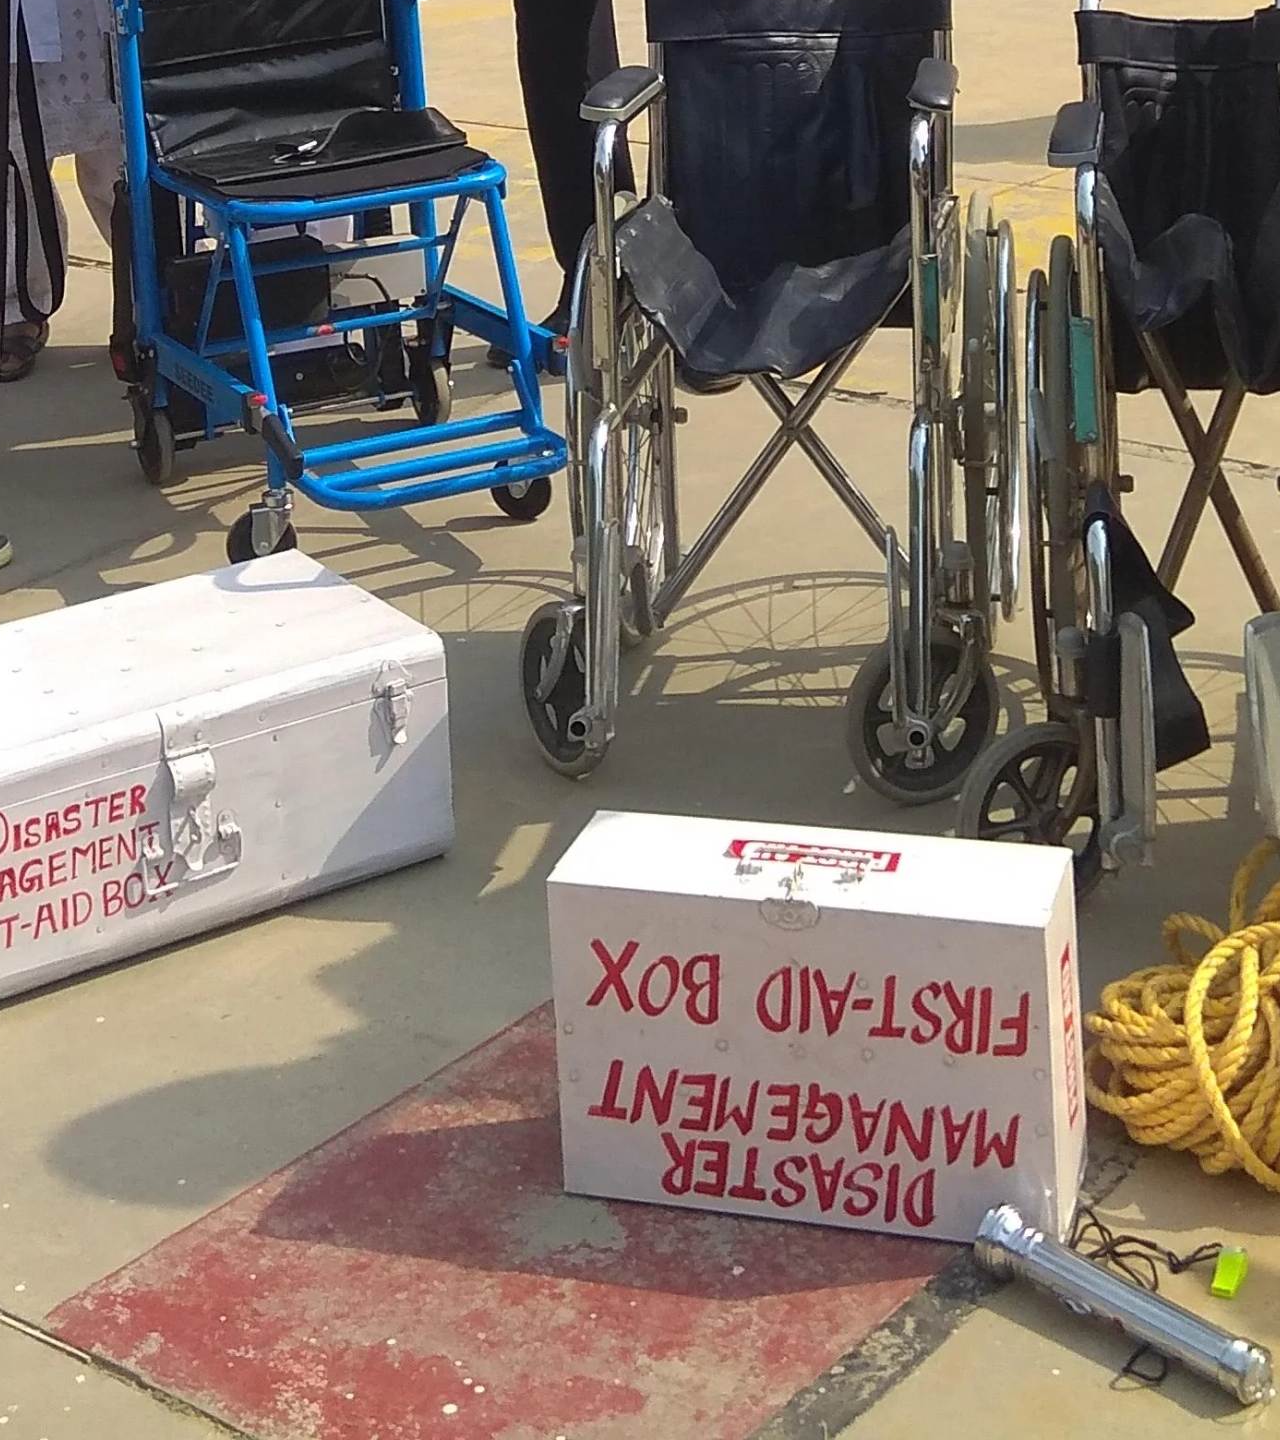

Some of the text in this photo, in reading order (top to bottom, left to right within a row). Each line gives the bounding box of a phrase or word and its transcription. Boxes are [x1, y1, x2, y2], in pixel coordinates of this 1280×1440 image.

[102, 860, 174, 918] BOX
[586, 938, 722, 1026] BOX
[755, 965, 1031, 1059] FIRST-AID
[587, 1059, 1021, 1170] MANAGEMENT
[661, 1132, 936, 1229] DISASTER
